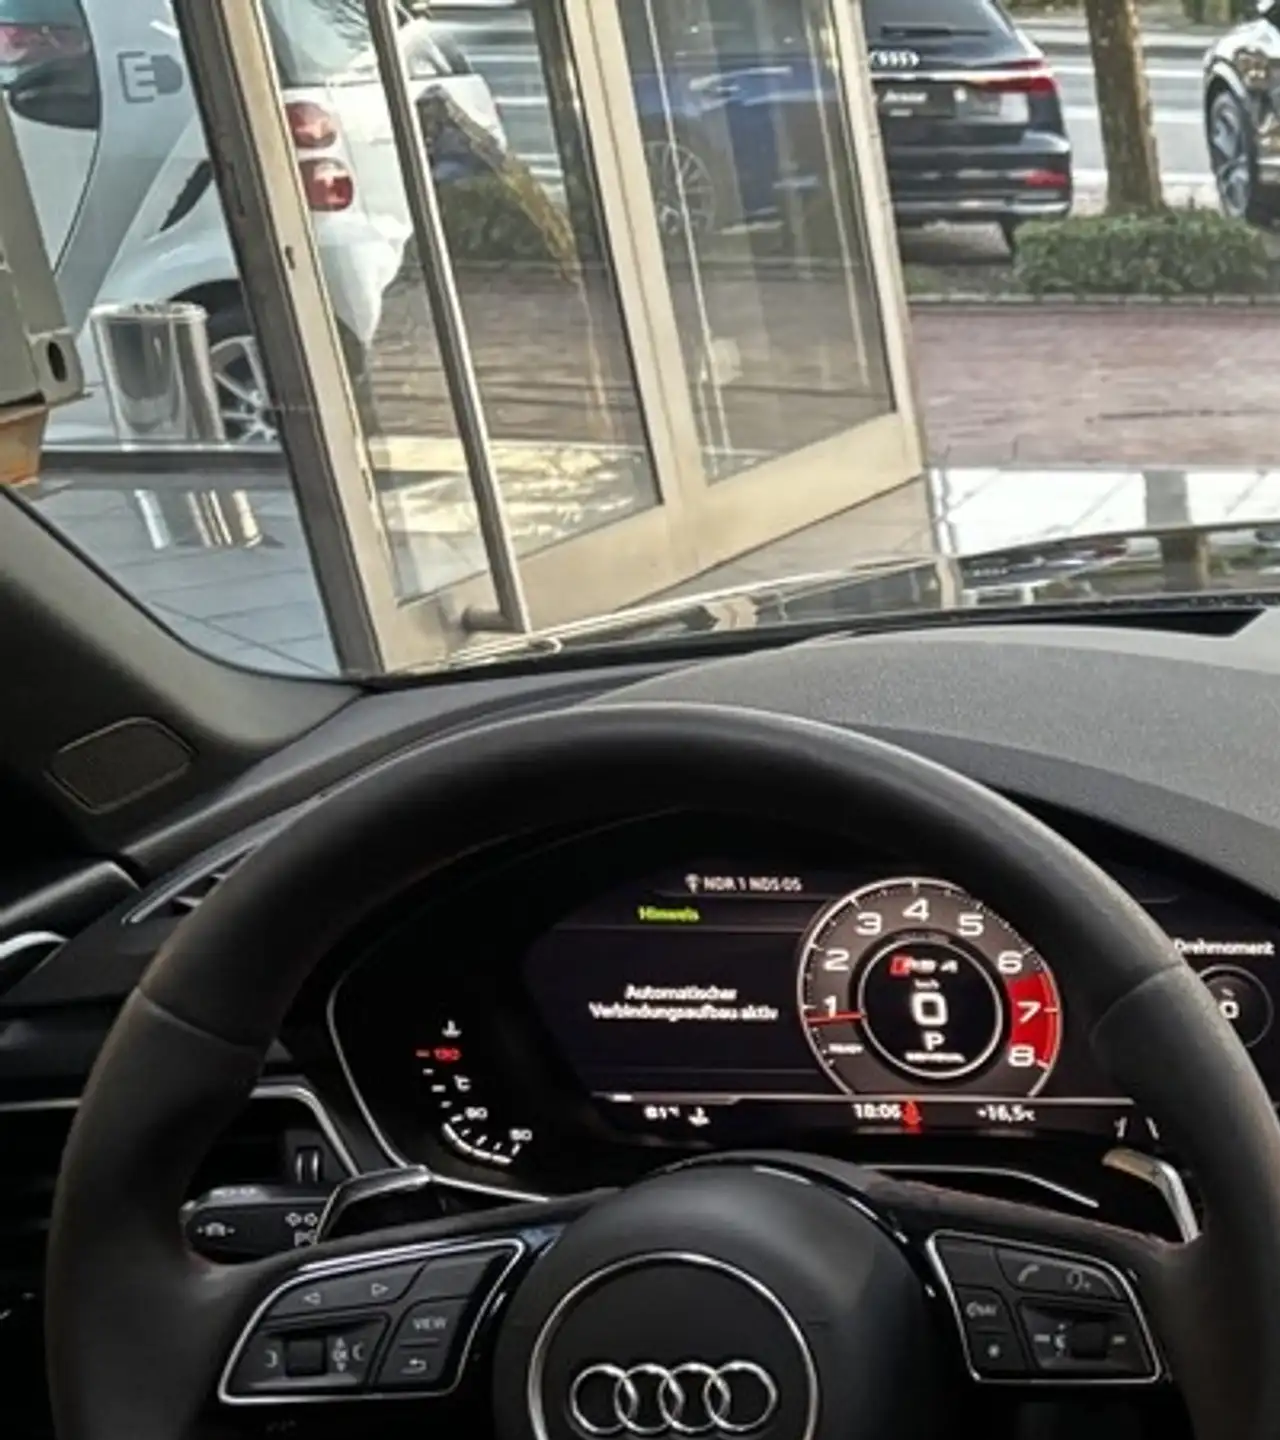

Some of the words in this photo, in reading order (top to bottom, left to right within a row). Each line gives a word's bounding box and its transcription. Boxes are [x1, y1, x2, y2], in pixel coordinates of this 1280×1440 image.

[638, 905, 699, 922] Hinweis
[903, 898, 930, 921] 4
[855, 912, 882, 936] 3
[957, 914, 984, 937] 5
[823, 950, 850, 972] 2
[998, 952, 1024, 974] 6
[624, 984, 738, 1001] Automatischer
[588, 1002, 738, 1022] Verbindungsaufbau
[741, 1005, 780, 1021] aktiv
[824, 995, 838, 1018] 1
[912, 991, 948, 1026] 0
[1017, 1001, 1042, 1023] 7
[923, 1031, 945, 1051] P
[1008, 1044, 1036, 1067] 8
[412, 1316, 447, 1331] VIEW
